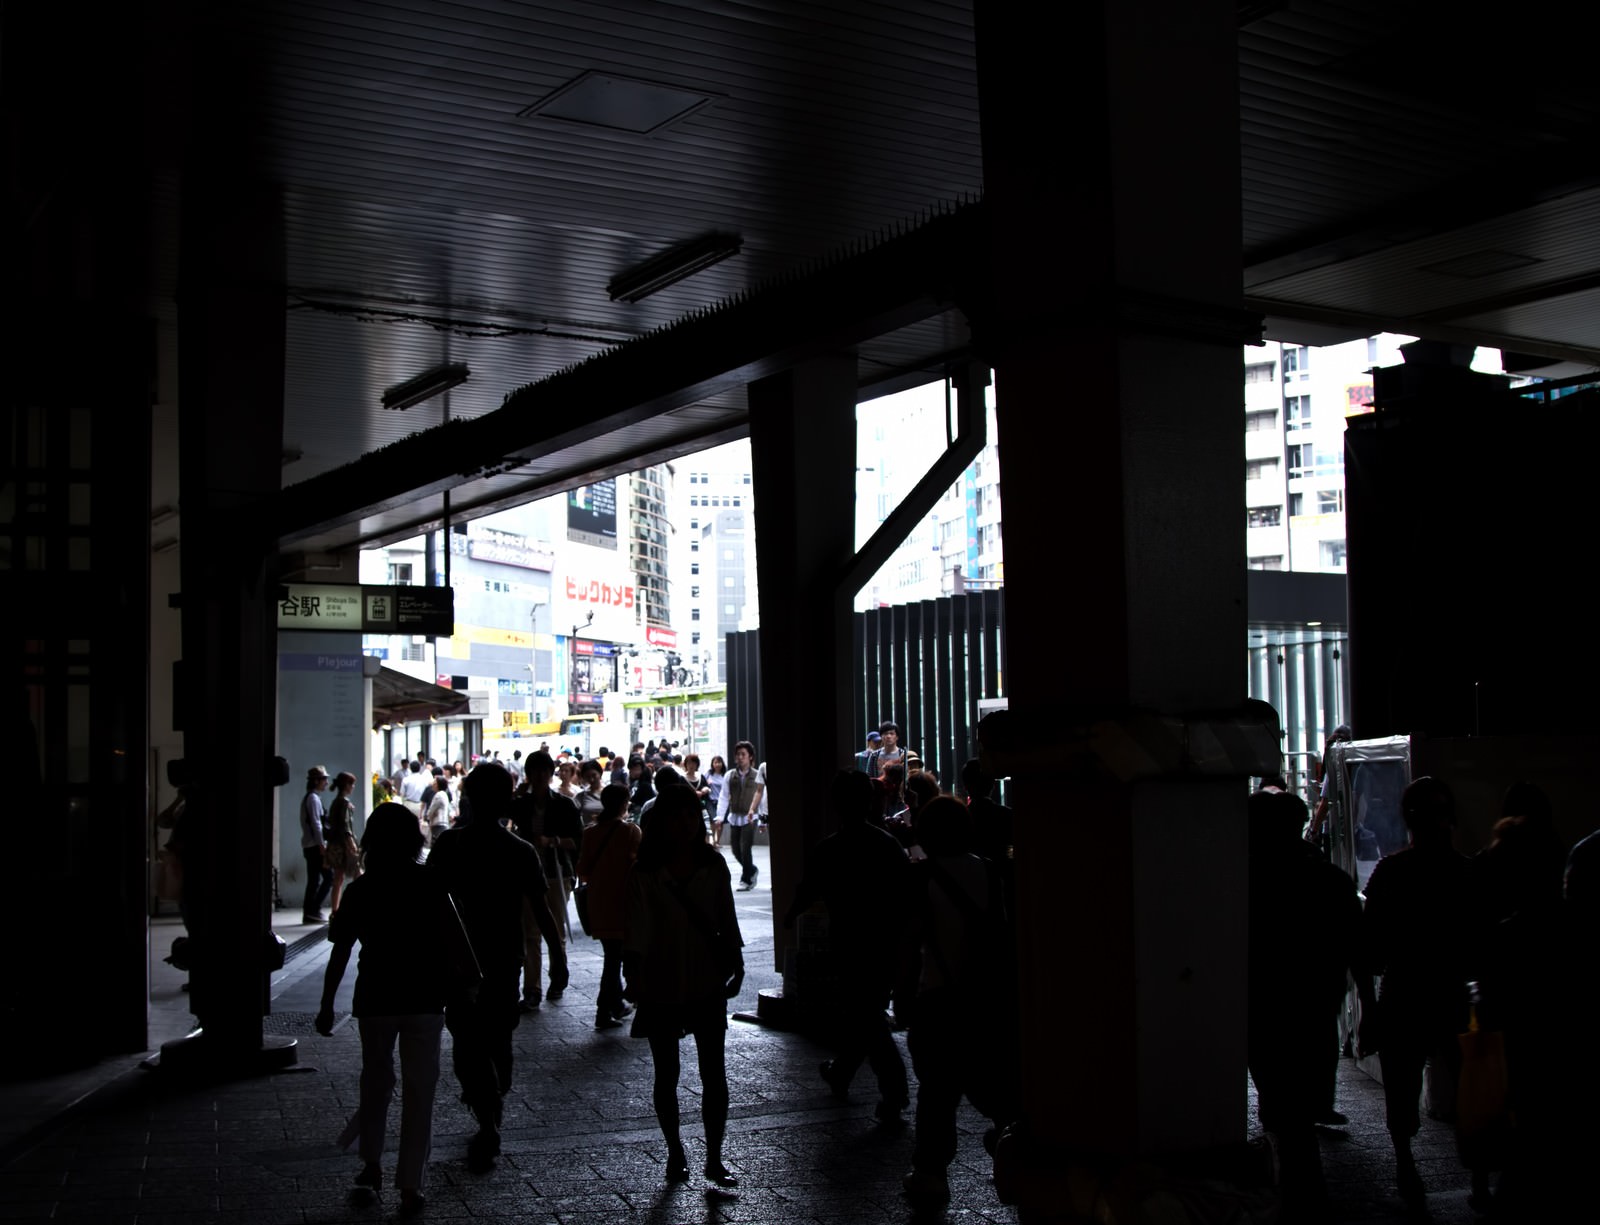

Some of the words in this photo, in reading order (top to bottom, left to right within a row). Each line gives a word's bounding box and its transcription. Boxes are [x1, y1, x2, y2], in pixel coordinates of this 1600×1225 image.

[565, 575, 634, 608] ビックカメラ
[280, 595, 320, 617] 谷駅
[318, 656, 359, 669] Plejour
